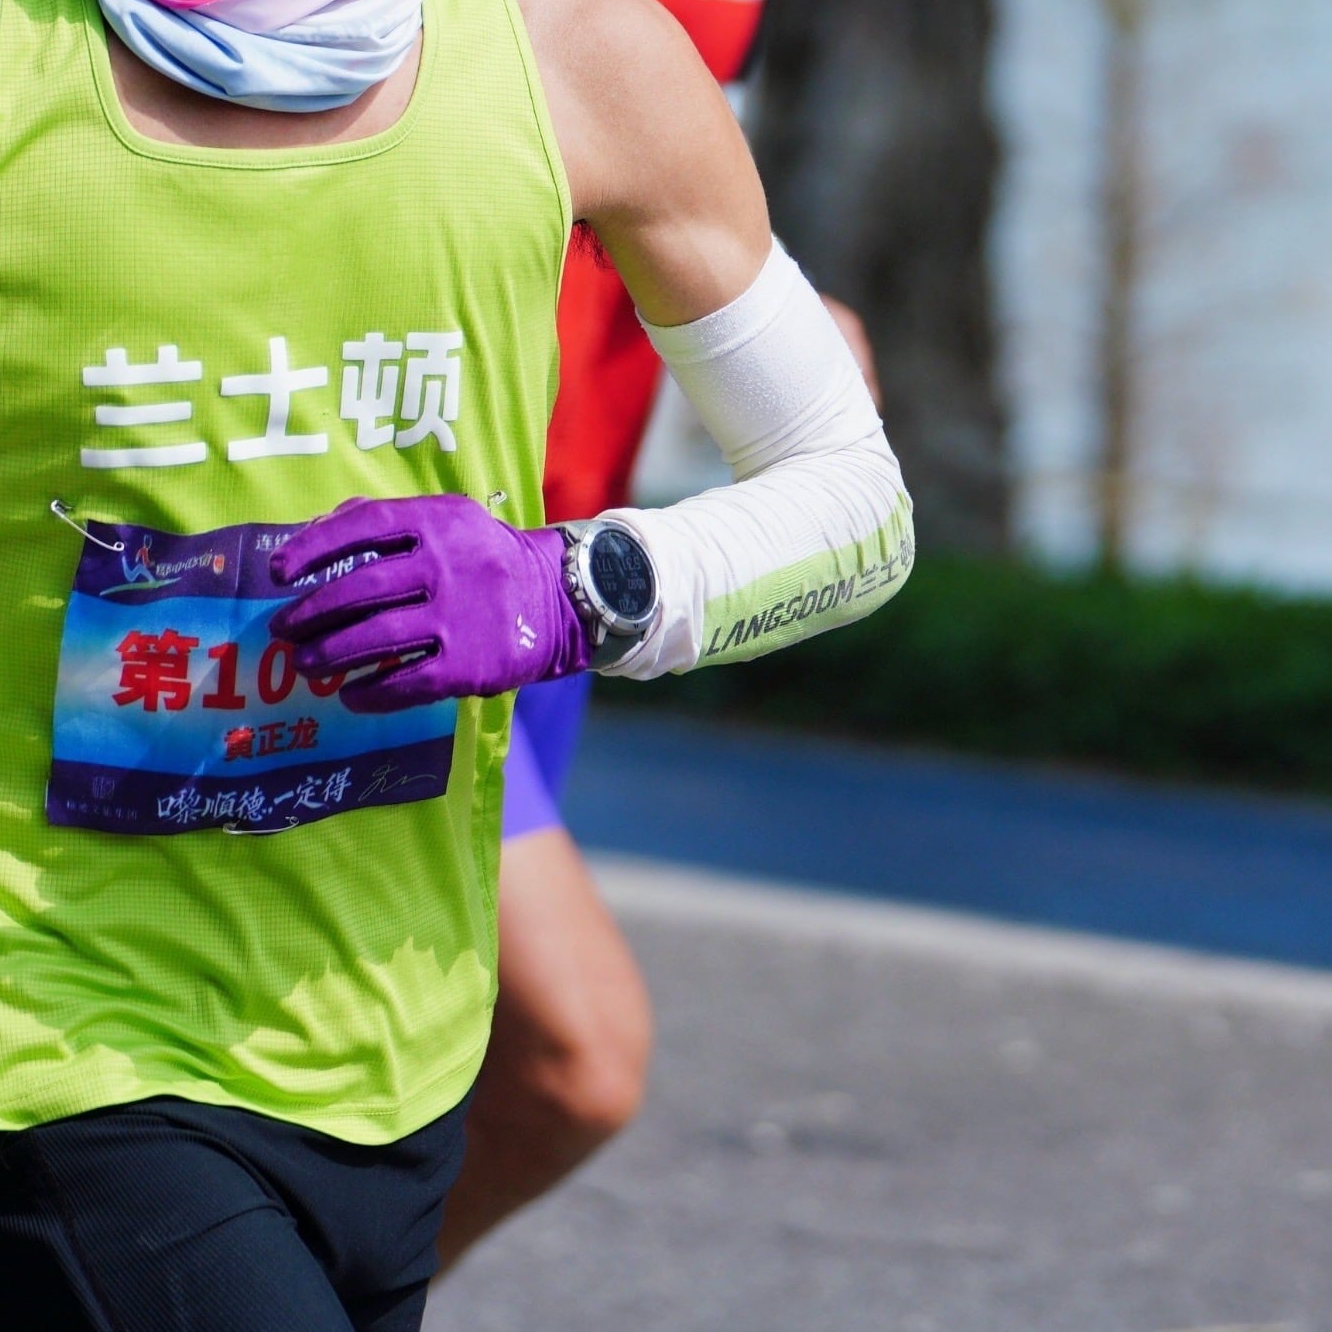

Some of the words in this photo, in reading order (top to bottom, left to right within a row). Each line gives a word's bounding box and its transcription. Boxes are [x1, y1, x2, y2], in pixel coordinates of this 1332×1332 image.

[80, 331, 464, 467] 兰士顿
[223, 716, 320, 762] 黄正龙
